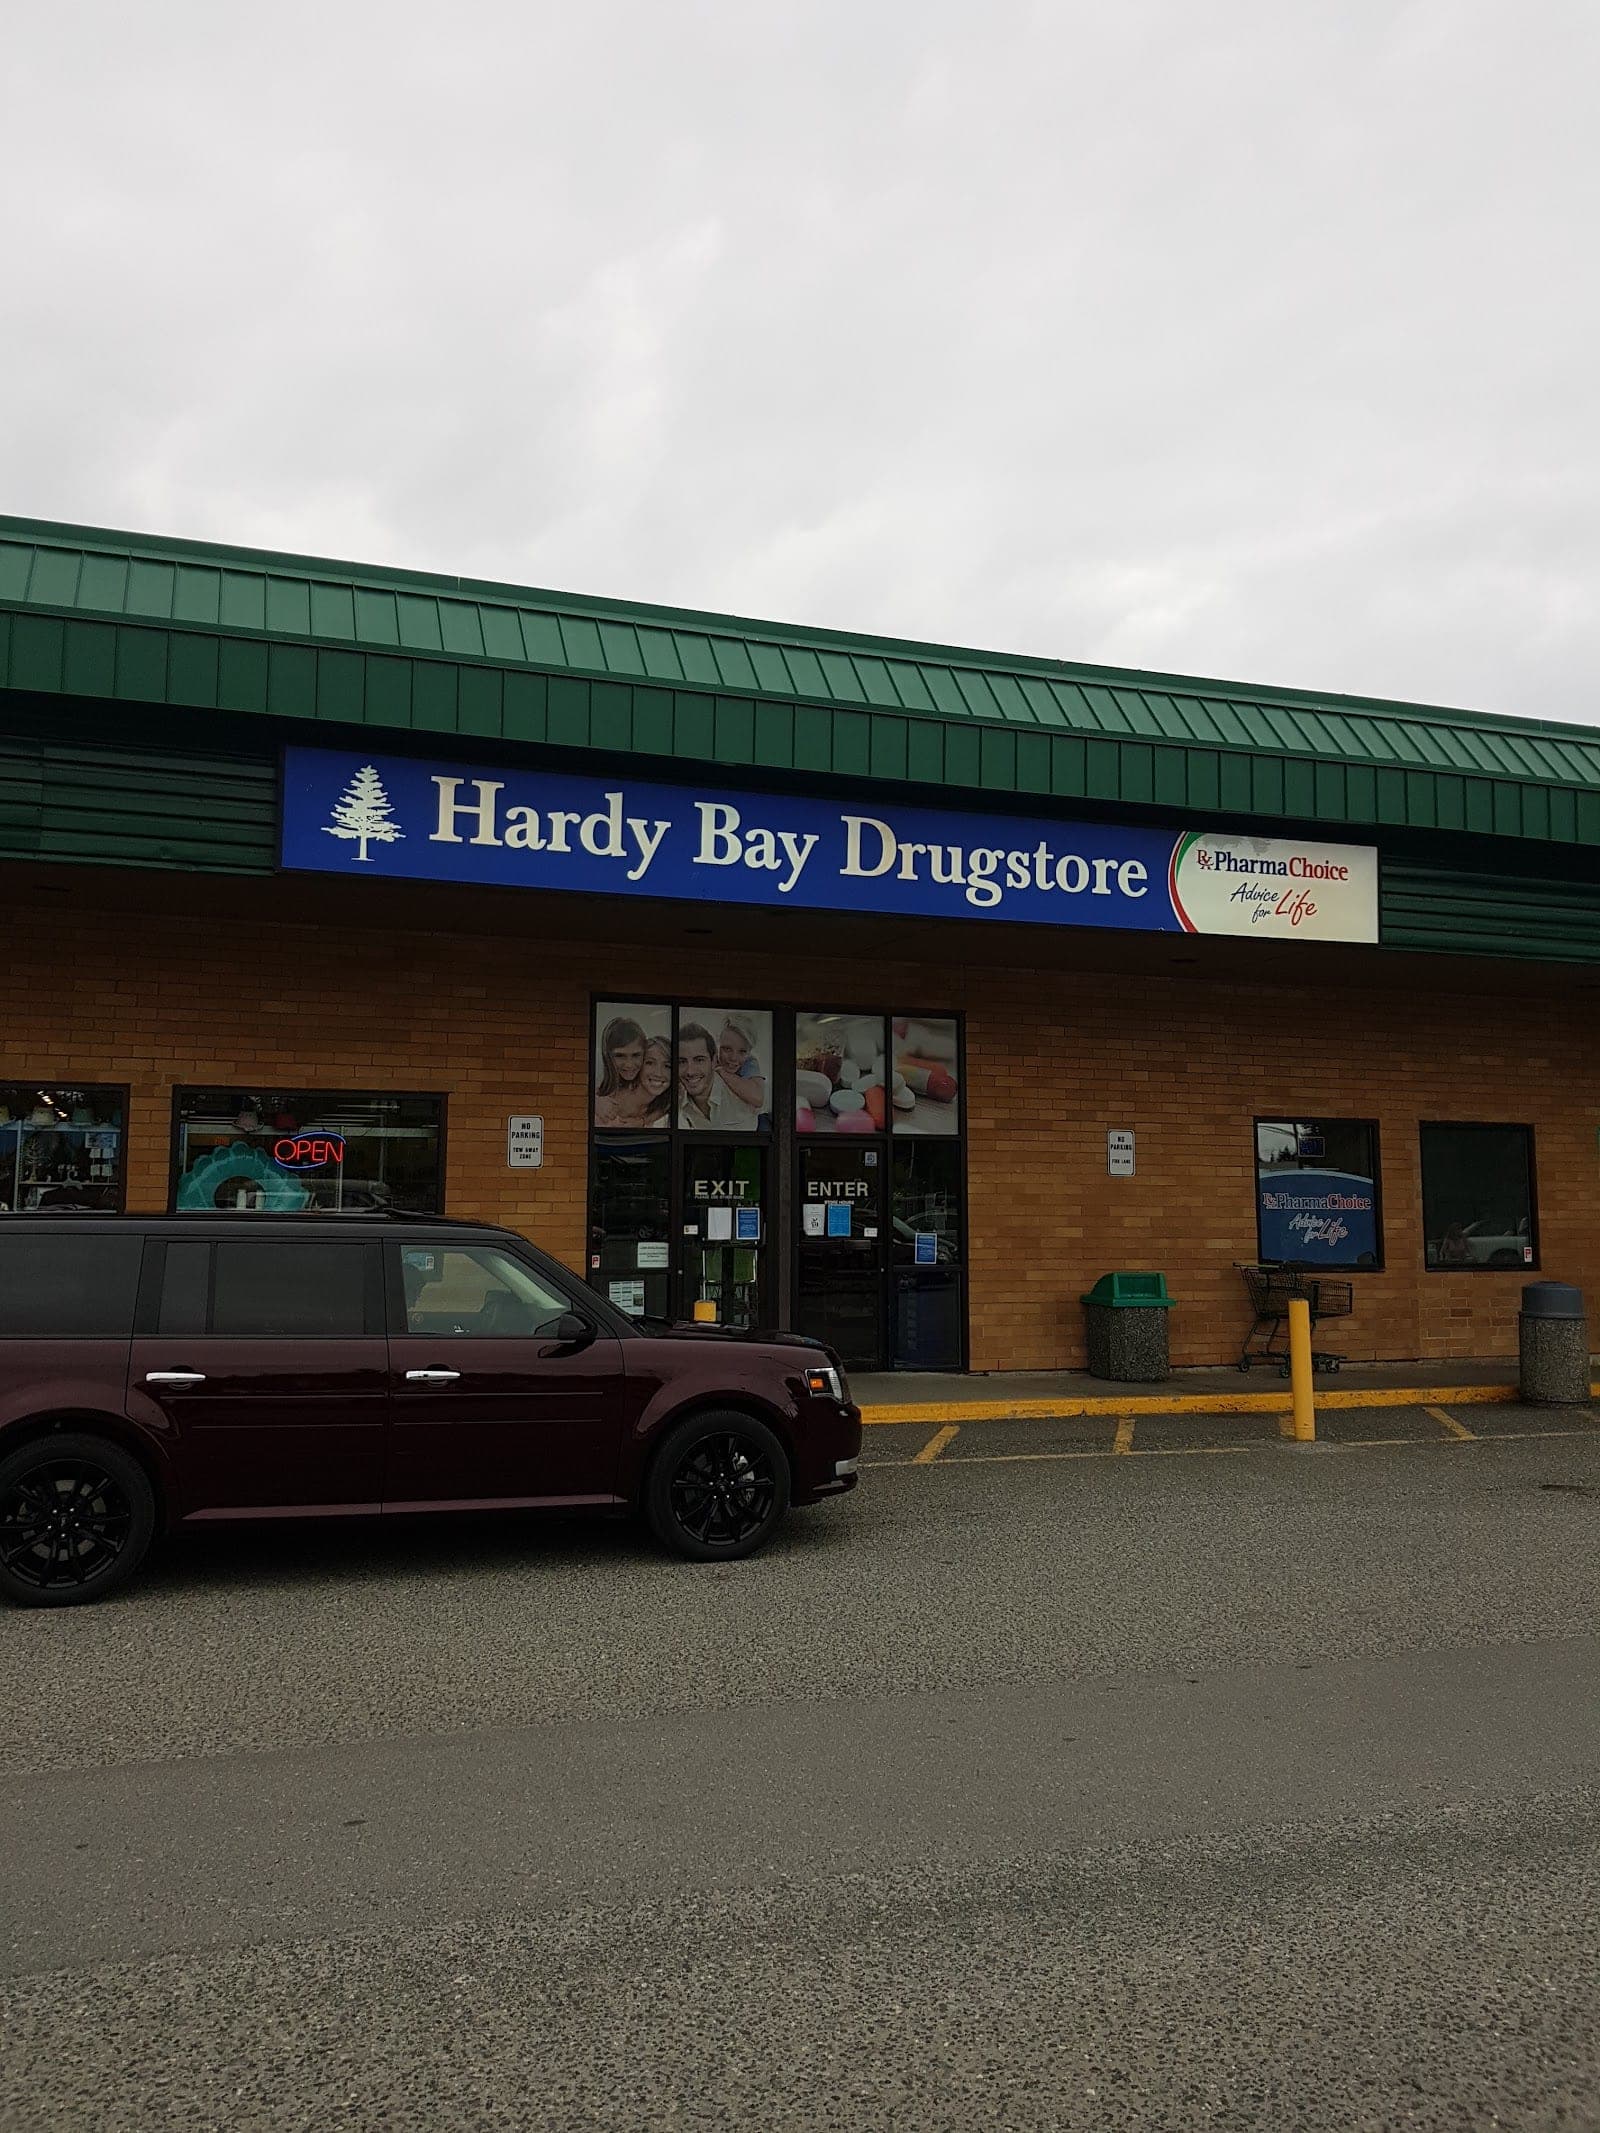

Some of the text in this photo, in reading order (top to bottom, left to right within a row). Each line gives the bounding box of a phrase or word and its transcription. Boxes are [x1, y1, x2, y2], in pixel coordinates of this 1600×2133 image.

[429, 775, 1148, 907] Hardy Bay Drugstore
[1230, 881, 1280, 903] Advice
[1251, 888, 1318, 926] for Life
[511, 1131, 540, 1139] PARKING
[521, 1122, 531, 1130] NO
[1117, 1135, 1125, 1143] NO
[274, 1139, 344, 1163] OPEN
[694, 1180, 750, 1195] EXIT
[807, 1181, 869, 1197] ENTER
[1288, 1213, 1324, 1231] Advice
[1318, 1217, 1349, 1247] Life
